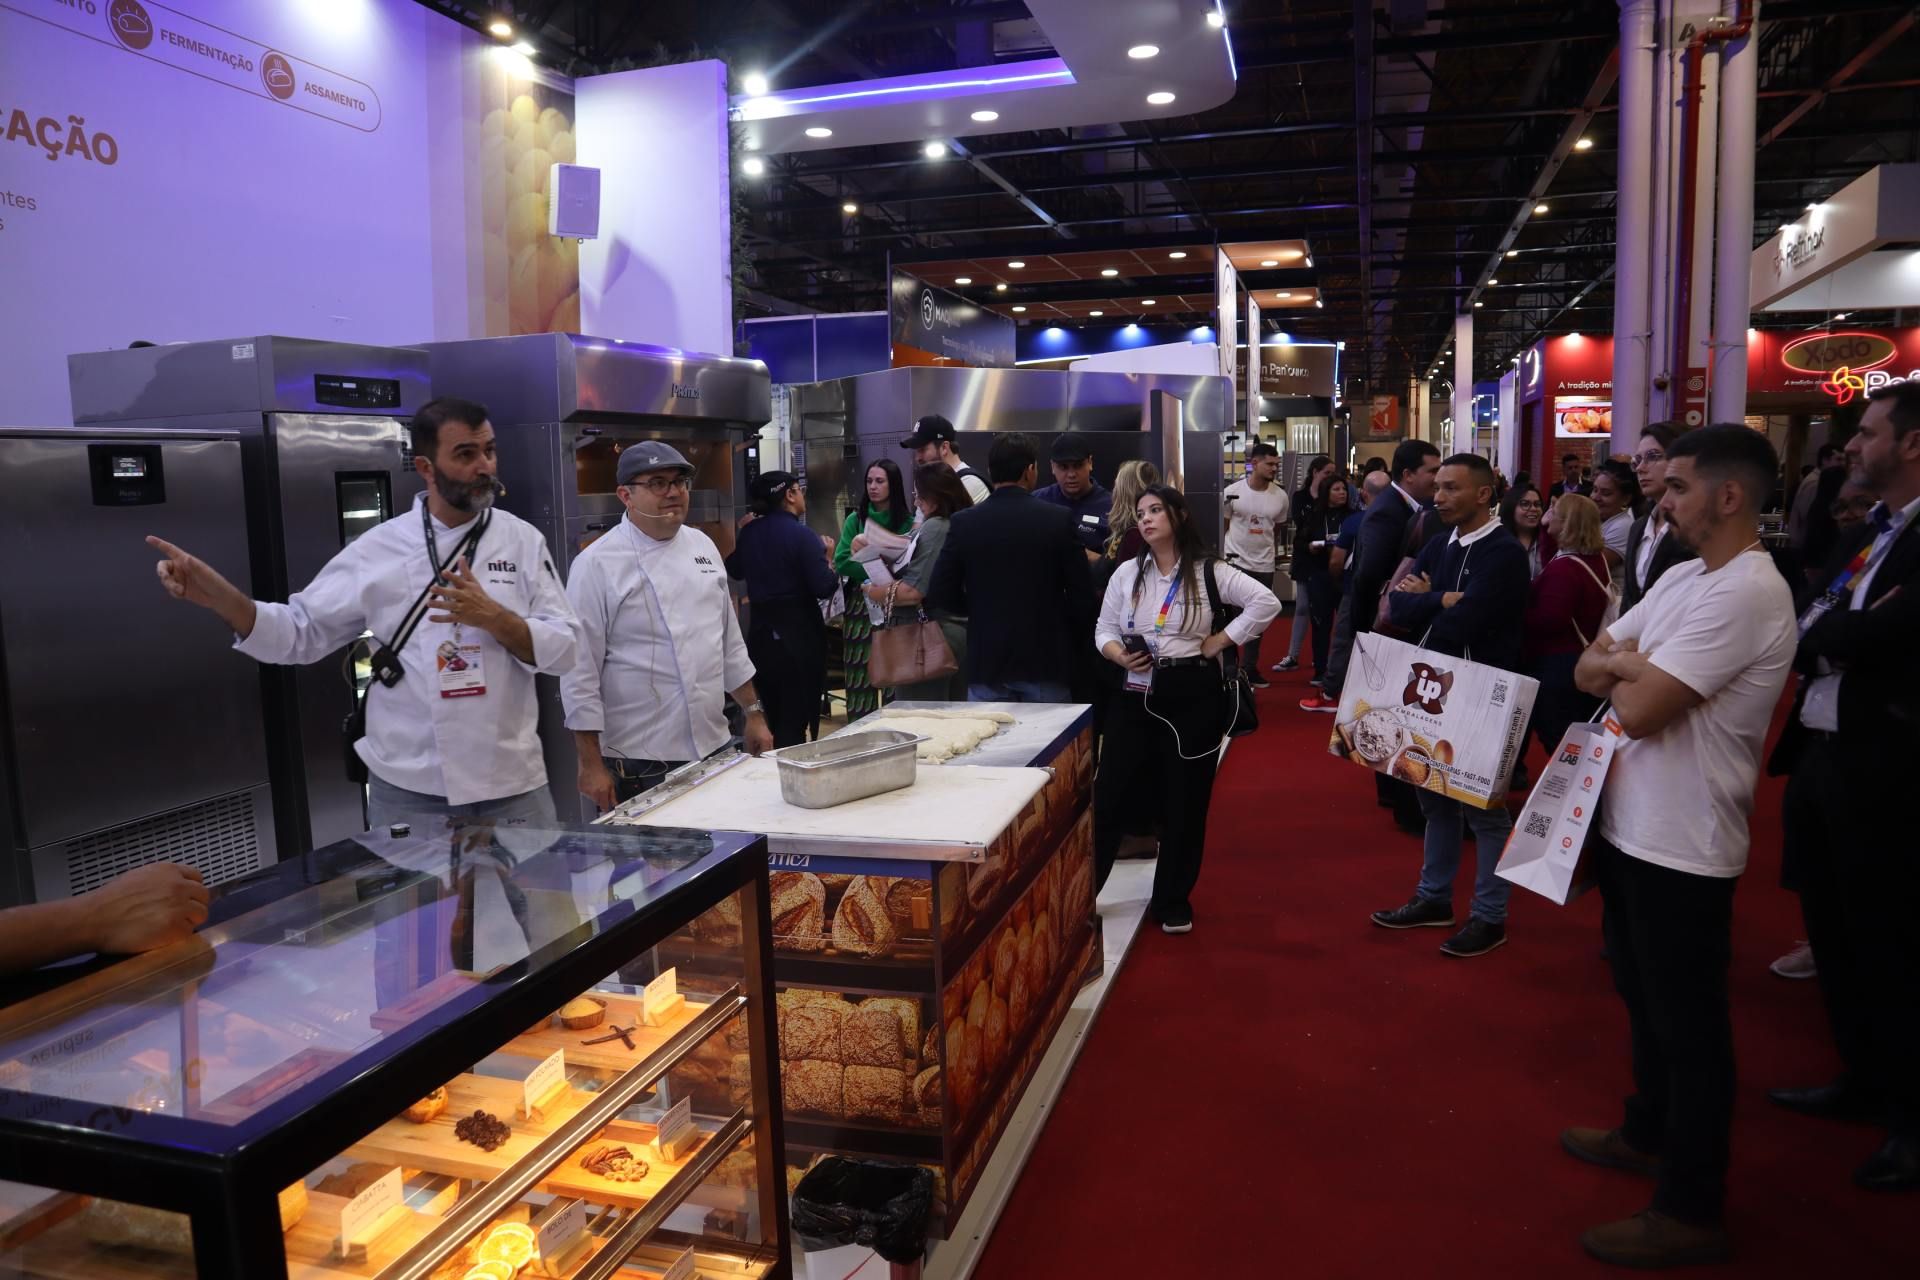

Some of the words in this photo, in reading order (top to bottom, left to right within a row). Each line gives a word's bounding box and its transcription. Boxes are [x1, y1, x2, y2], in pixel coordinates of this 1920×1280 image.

[55, 0, 97, 15] NTO
[159, 28, 254, 73] FERMENTAÇÃO
[304, 82, 366, 112] ASSAMENTO
[0, 108, 118, 165] AÇÃO
[1558, 381, 1566, 389] A
[1567, 380, 1600, 391] tradição
[488, 559, 517, 573] nita
[1416, 669, 1442, 704] ip
[1497, 706, 1523, 780] ipembalagens.com.br
[1558, 751, 1579, 766] LAB
